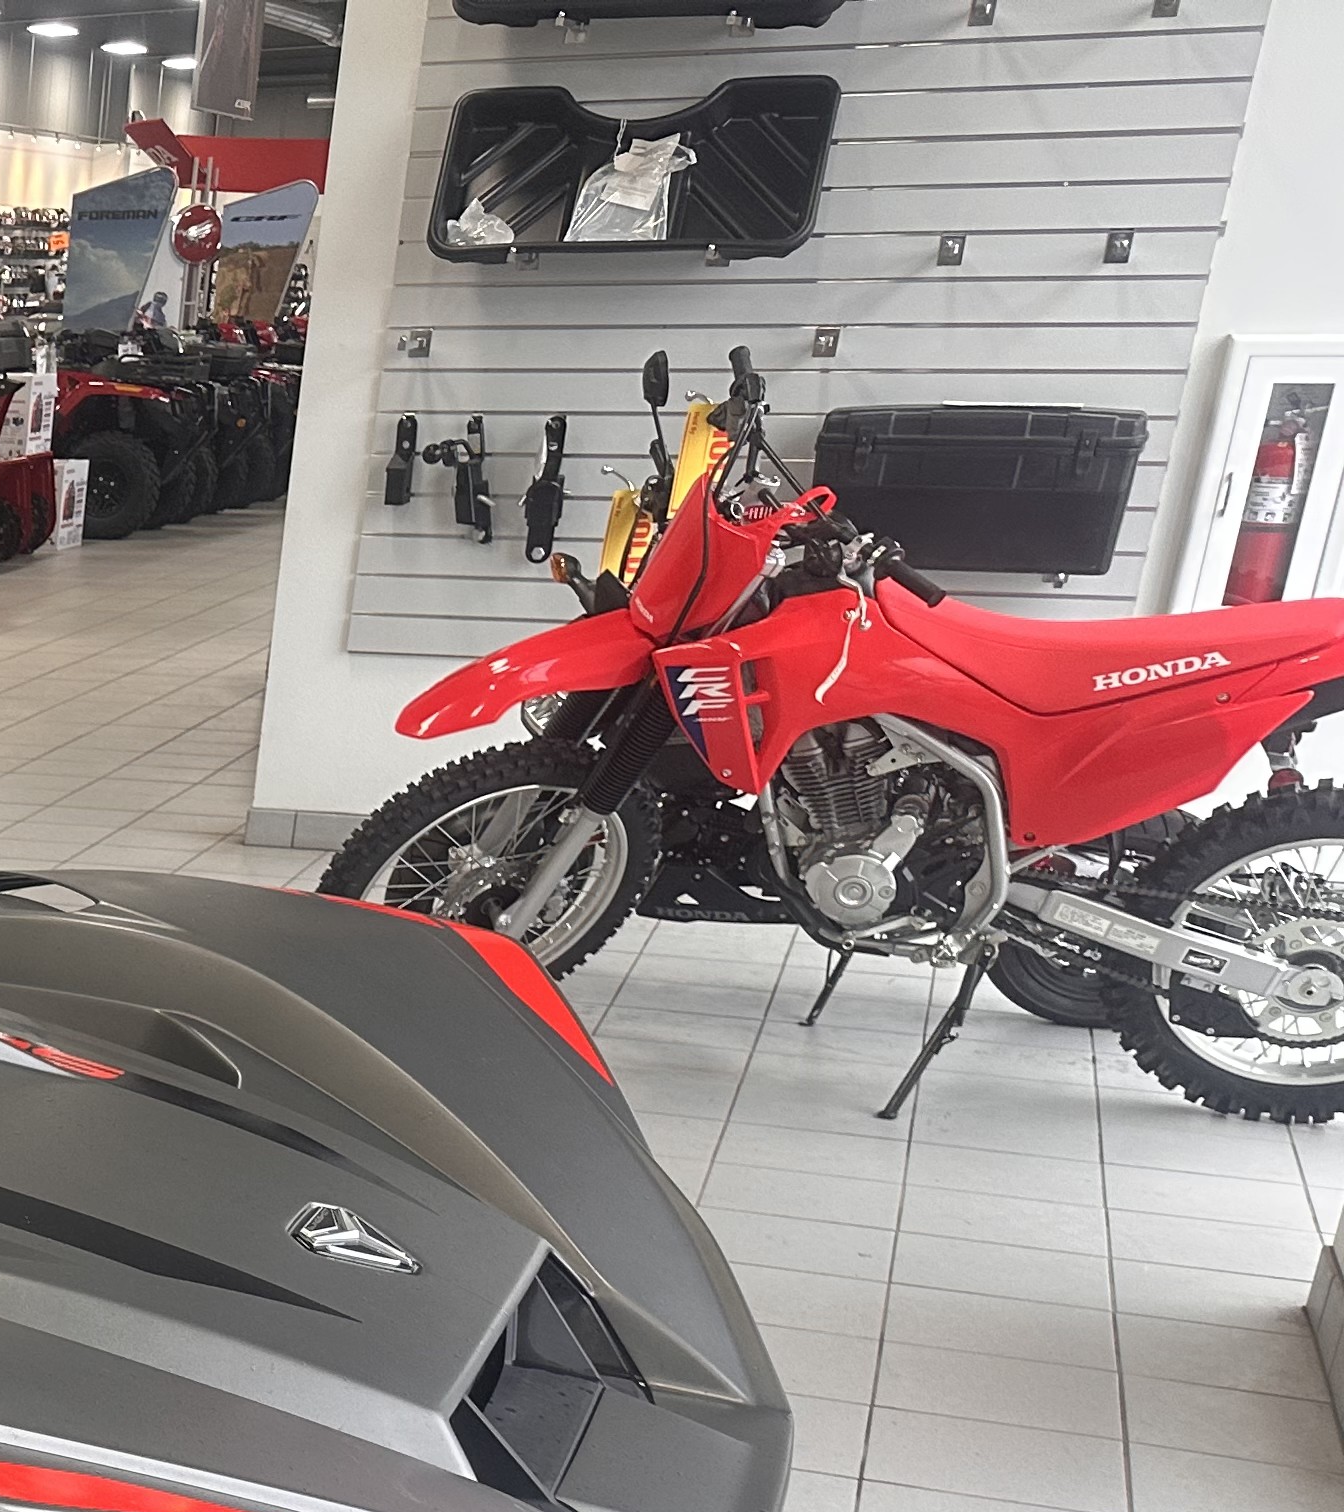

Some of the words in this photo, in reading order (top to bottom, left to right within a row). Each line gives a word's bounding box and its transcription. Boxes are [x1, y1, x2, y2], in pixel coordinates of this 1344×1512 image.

[77, 208, 159, 222] FOREMAN
[1091, 651, 1232, 692] HONDA
[656, 904, 752, 923] HONDA
